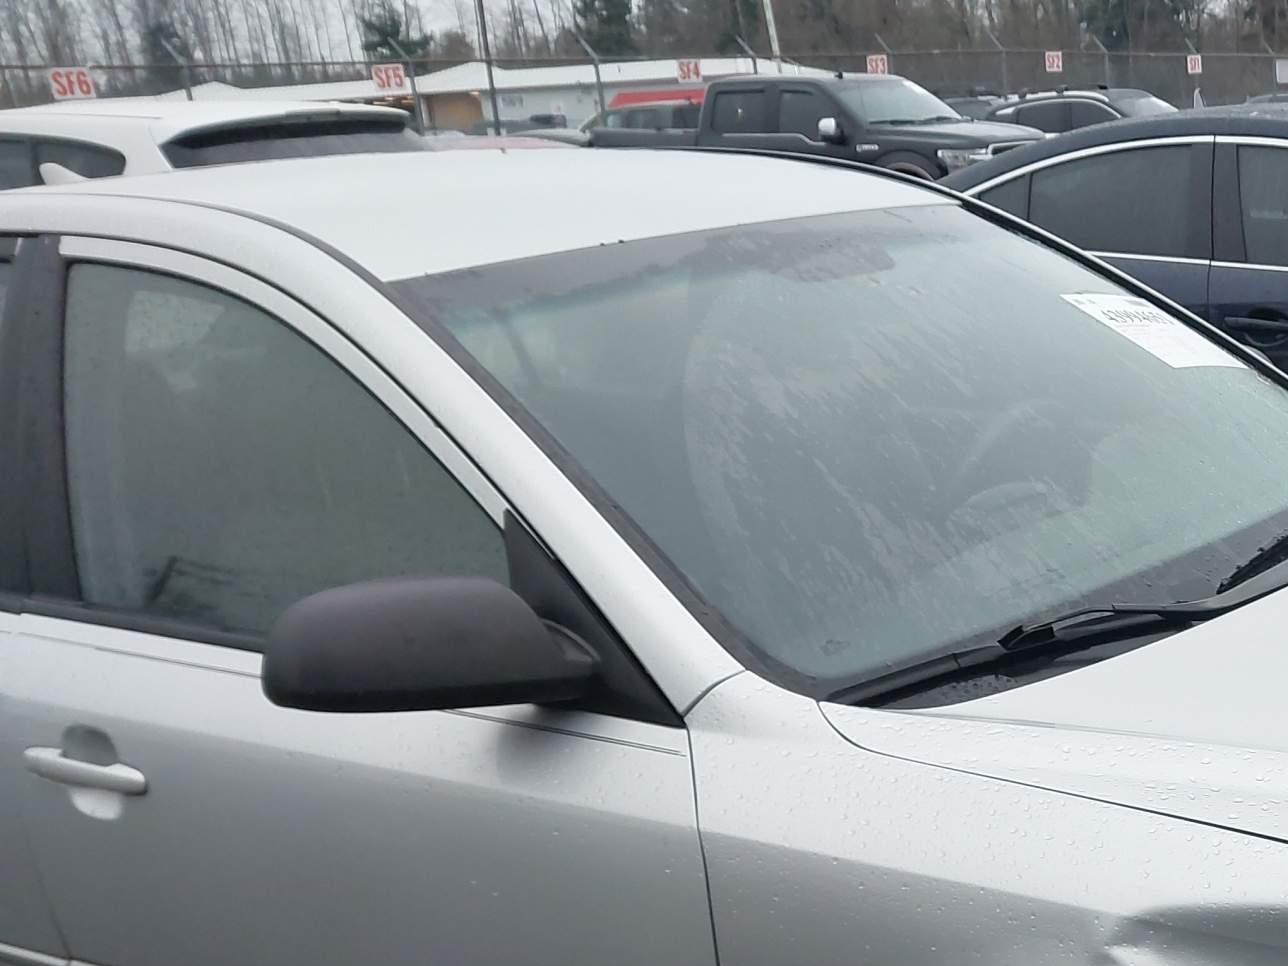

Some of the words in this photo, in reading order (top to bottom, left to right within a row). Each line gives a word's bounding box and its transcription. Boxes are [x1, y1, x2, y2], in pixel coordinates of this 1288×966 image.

[679, 61, 700, 80] SF4
[869, 57, 885, 74] SF3
[51, 70, 91, 97] SF6
[374, 66, 403, 89] SF5
